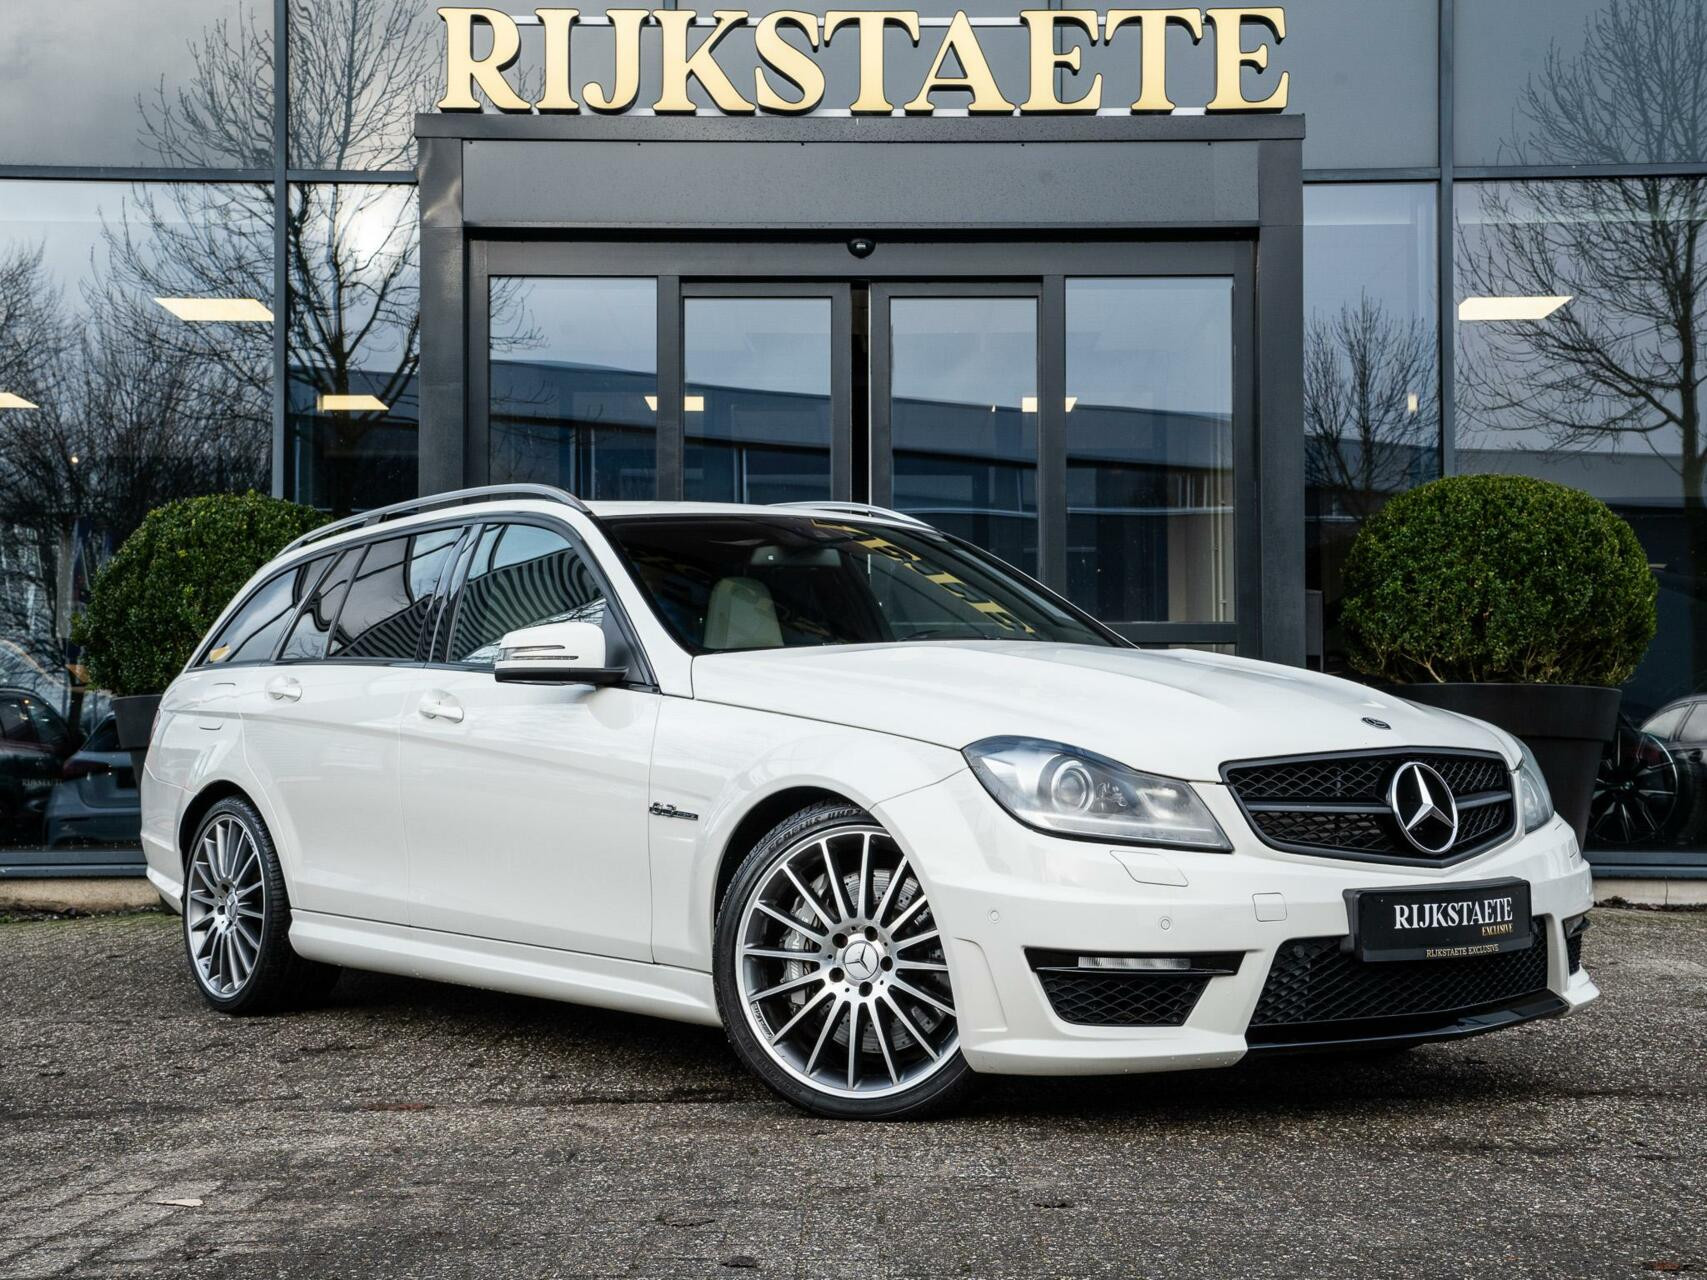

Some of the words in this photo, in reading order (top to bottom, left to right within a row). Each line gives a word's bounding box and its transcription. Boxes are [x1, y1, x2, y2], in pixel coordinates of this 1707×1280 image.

[437, 7, 1290, 113] RIJKSTAETE
[1394, 898, 1513, 929] RIJKSTAETE
[1426, 947, 1468, 958] RIJKSTAETE
[1468, 945, 1499, 955] EXCLUSIVE
